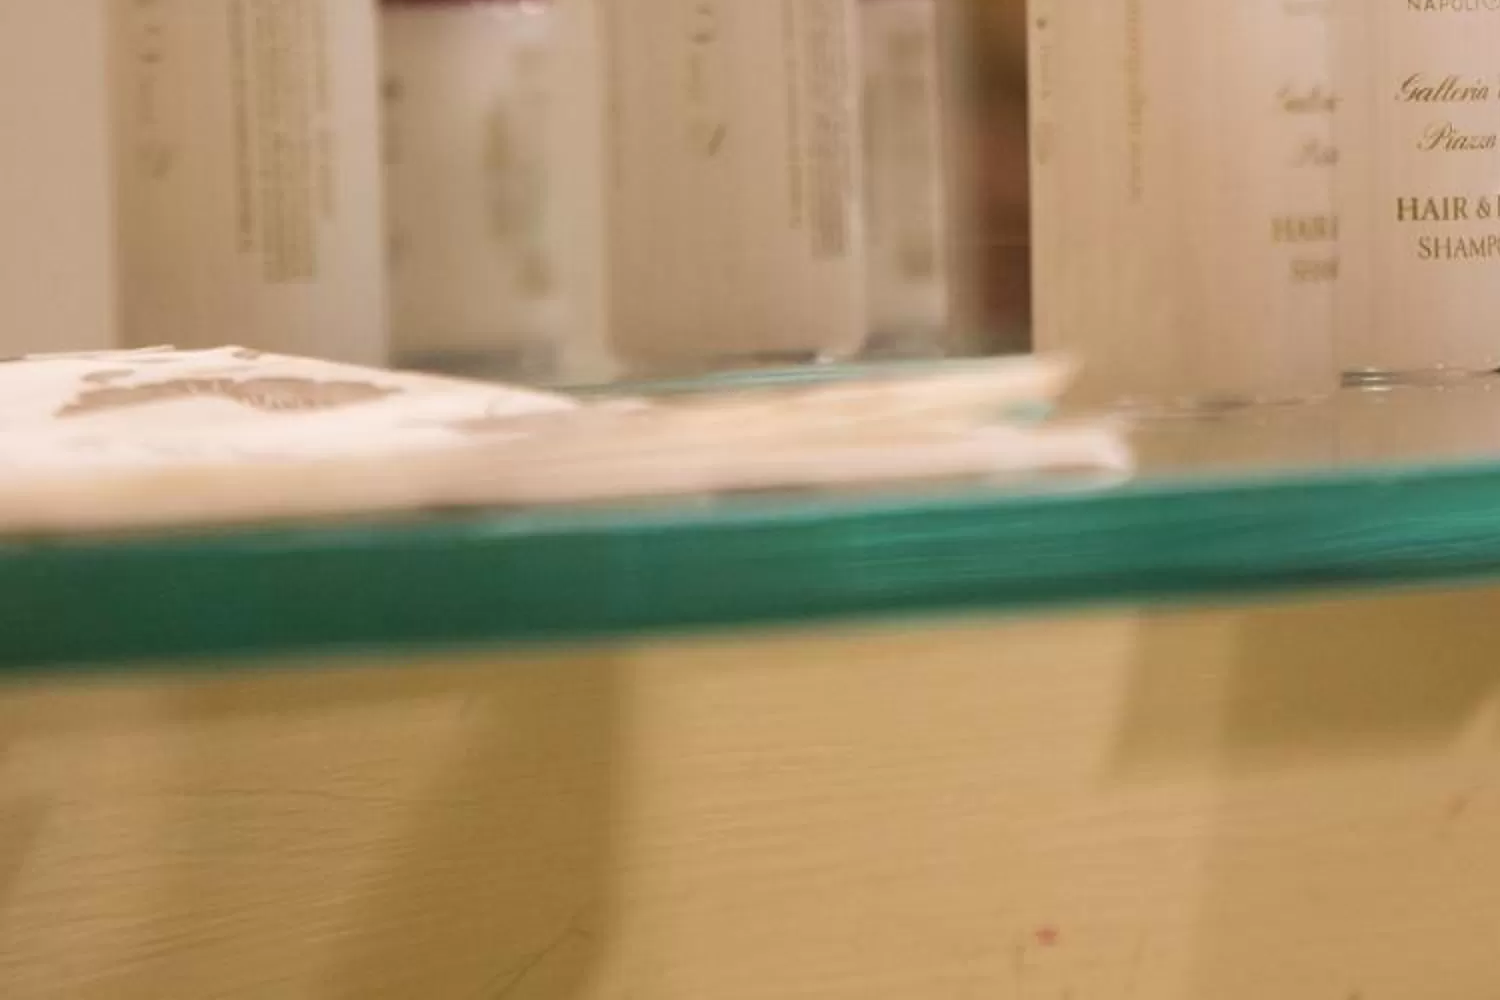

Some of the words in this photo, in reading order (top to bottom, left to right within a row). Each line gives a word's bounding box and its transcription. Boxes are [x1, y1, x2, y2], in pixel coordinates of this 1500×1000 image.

[1394, 72, 1489, 102] Galleria
[1416, 119, 1497, 151] Piazza
[1396, 196, 1468, 221] HAIR
[1475, 195, 1492, 219] &
